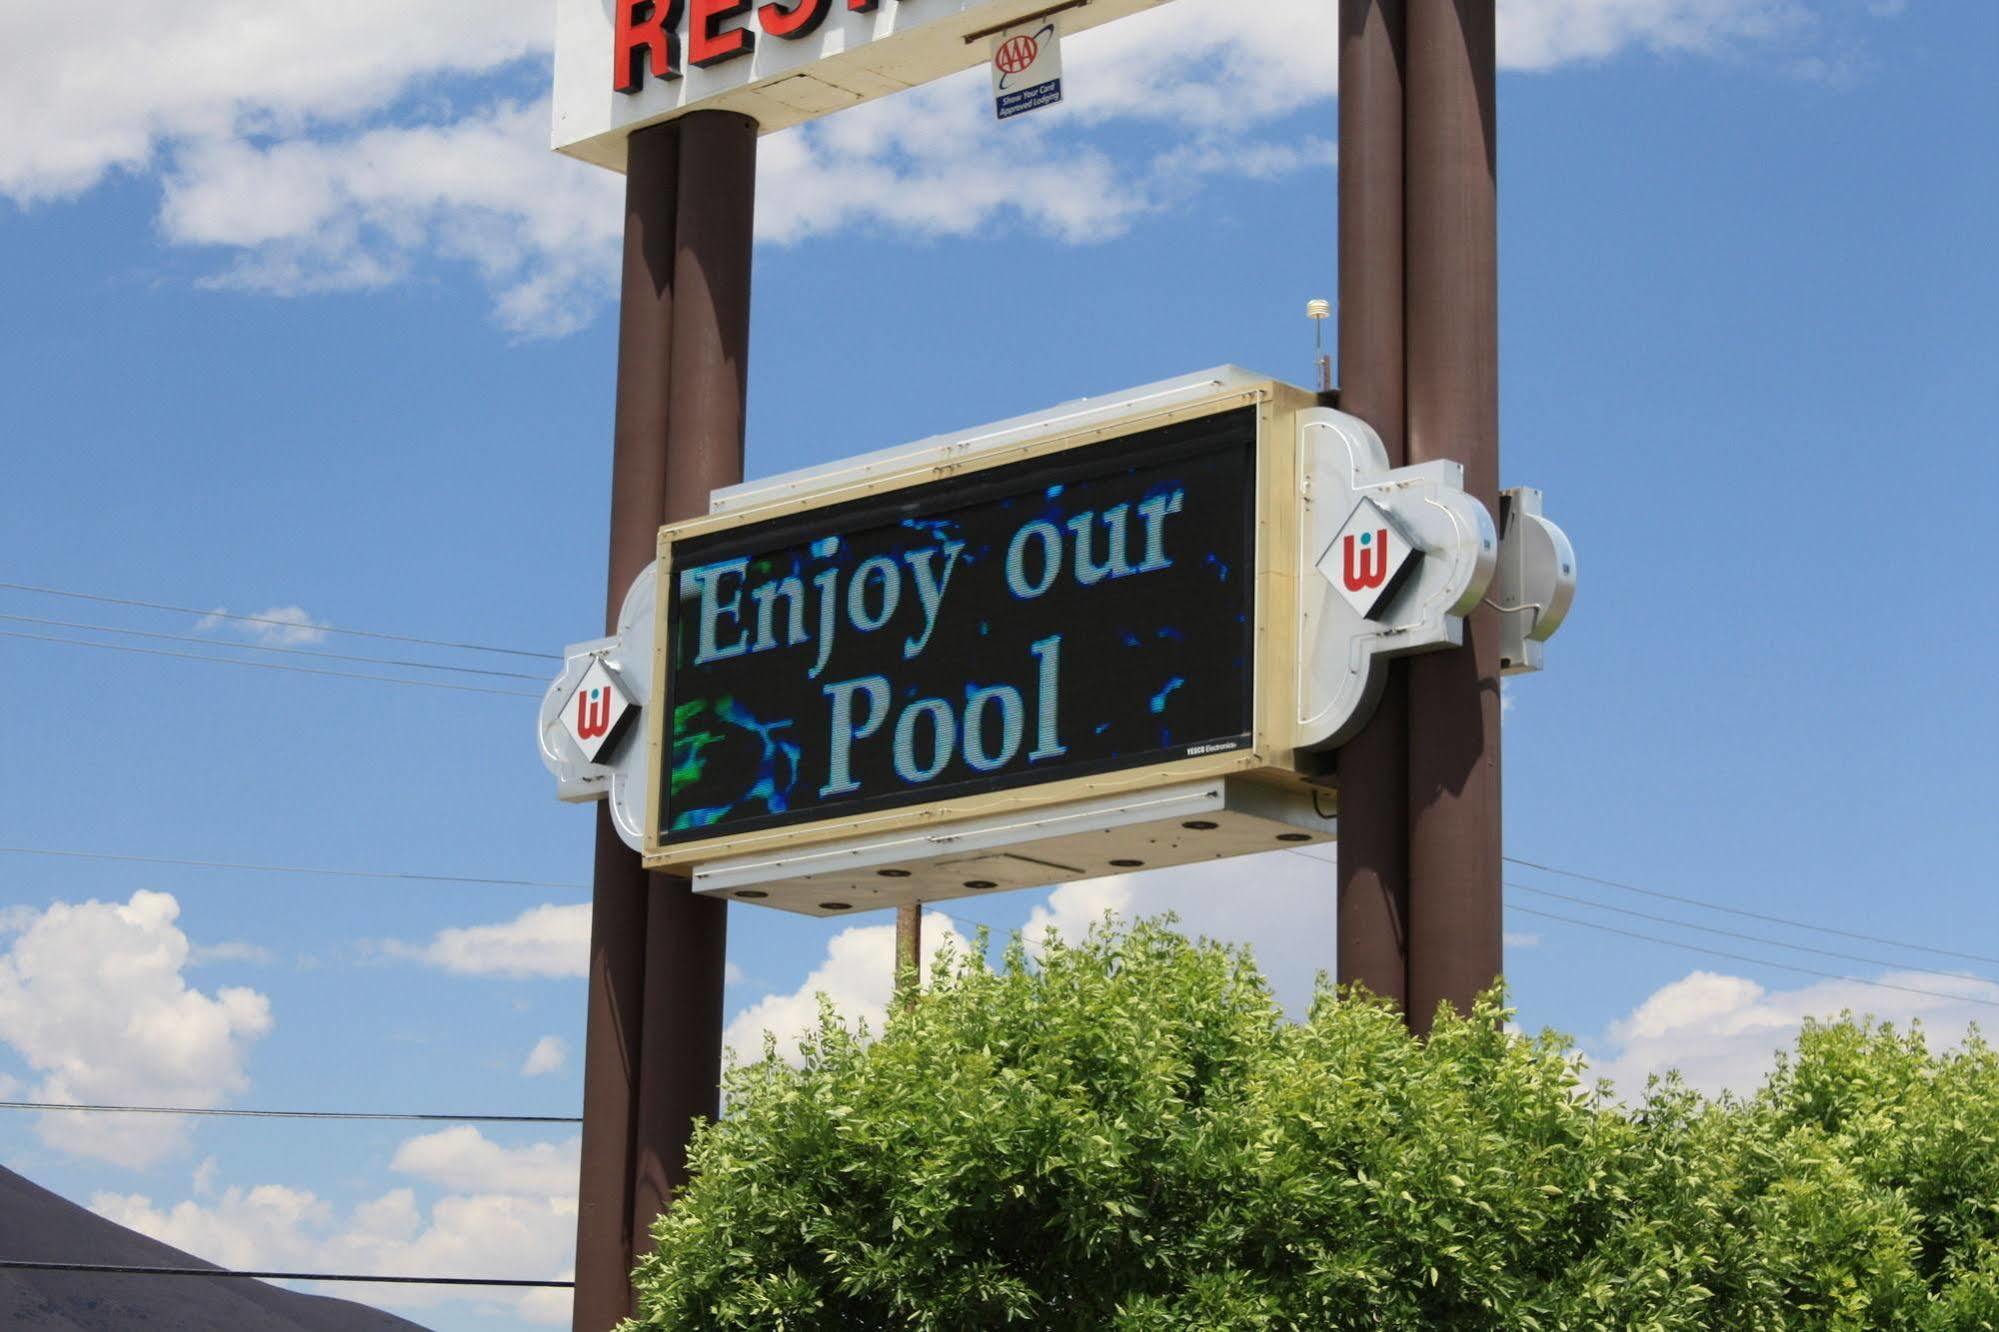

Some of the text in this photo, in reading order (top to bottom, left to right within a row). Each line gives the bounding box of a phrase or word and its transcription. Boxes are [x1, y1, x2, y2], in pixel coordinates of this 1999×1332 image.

[998, 36, 1036, 73] AAA
[999, 91, 1060, 116] Approved Lodging
[1021, 88, 1039, 99] Your
[1039, 82, 1056, 93] Card
[694, 488, 1185, 679] Enjoy our
[818, 633, 1068, 798] Pool
